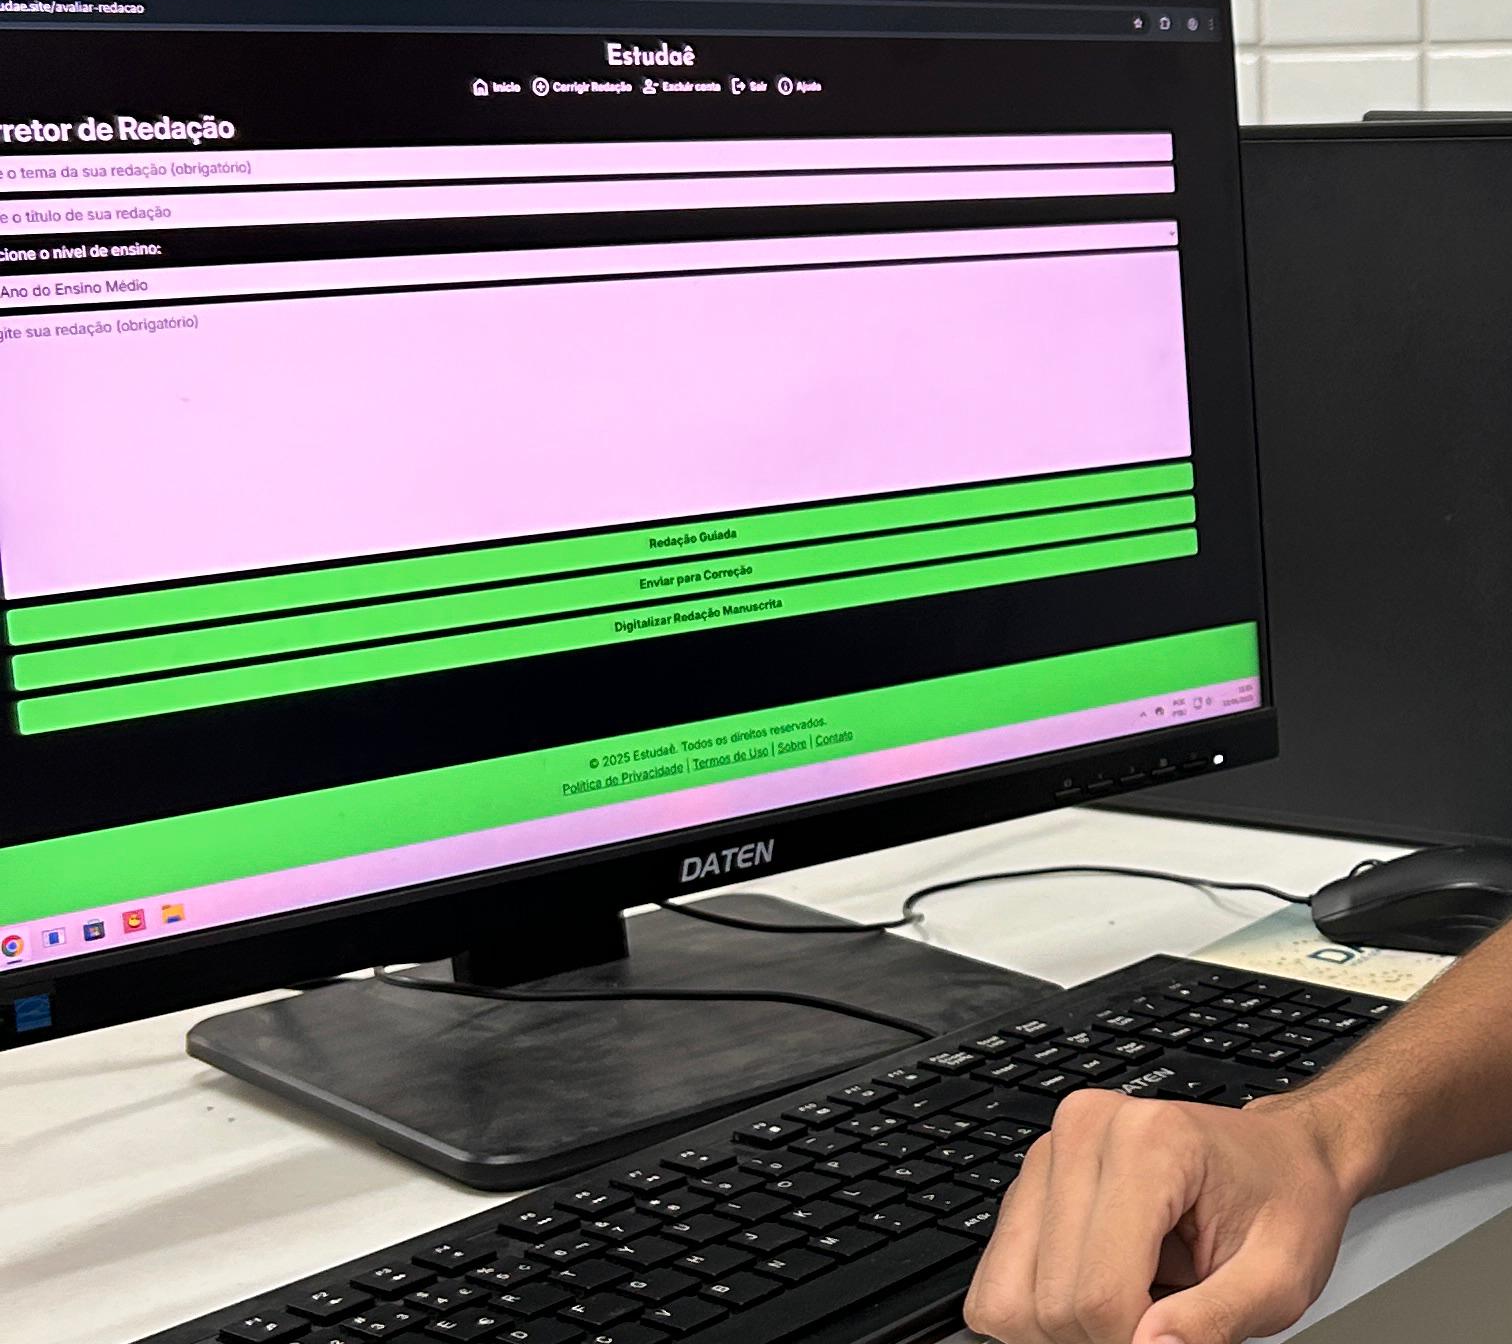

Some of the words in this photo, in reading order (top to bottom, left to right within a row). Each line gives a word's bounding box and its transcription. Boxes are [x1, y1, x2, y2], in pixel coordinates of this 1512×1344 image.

[607, 42, 696, 66] Estudaê
[77, 117, 113, 142] de
[117, 115, 235, 145] Redação
[7, 169, 16, 179] o
[21, 166, 56, 179] tema
[61, 166, 78, 178] da
[83, 167, 107, 178] sua
[111, 163, 167, 179] redação
[171, 161, 252, 177] (obrigatório)
[13, 213, 21, 223] o
[26, 207, 61, 223] título
[65, 207, 84, 221] de
[88, 209, 112, 221] sua
[116, 206, 171, 221] redação
[40, 251, 50, 260] o
[53, 244, 87, 259] nível
[90, 243, 109, 258] de
[111, 242, 162, 256] ensino:
[0, 286, 28, 298] Ano
[32, 284, 50, 297] do
[55, 282, 101, 295] Ensino
[105, 279, 148, 293] Médio
[26, 327, 52, 339] sua
[55, 322, 112, 337] redação
[117, 315, 199, 334] (obrigatório)
[649, 533, 698, 549] Redação
[699, 528, 737, 543] Guiada
[639, 574, 674, 589] Enviar
[677, 574, 702, 587] para
[703, 565, 753, 581] Correção
[614, 616, 672, 634] Digitalizar
[673, 608, 720, 624] Redação
[722, 599, 783, 616] Manuscrita
[603, 752, 631, 768] 2025
[681, 737, 713, 752] Todos
[715, 736, 728, 746] os
[731, 727, 767, 743] direitos
[770, 717, 827, 736] reservados.
[605, 774, 619, 787] de
[621, 762, 684, 784] Privacidade
[692, 754, 731, 770] Termos
[733, 750, 747, 762] de
[749, 747, 769, 760] Uso
[777, 739, 808, 755] Sobre
[815, 730, 853, 747] Contato
[681, 839, 775, 883] DATEN
[1112, 1067, 1176, 1094] ATEN
[436, 1319, 457, 1330] E
